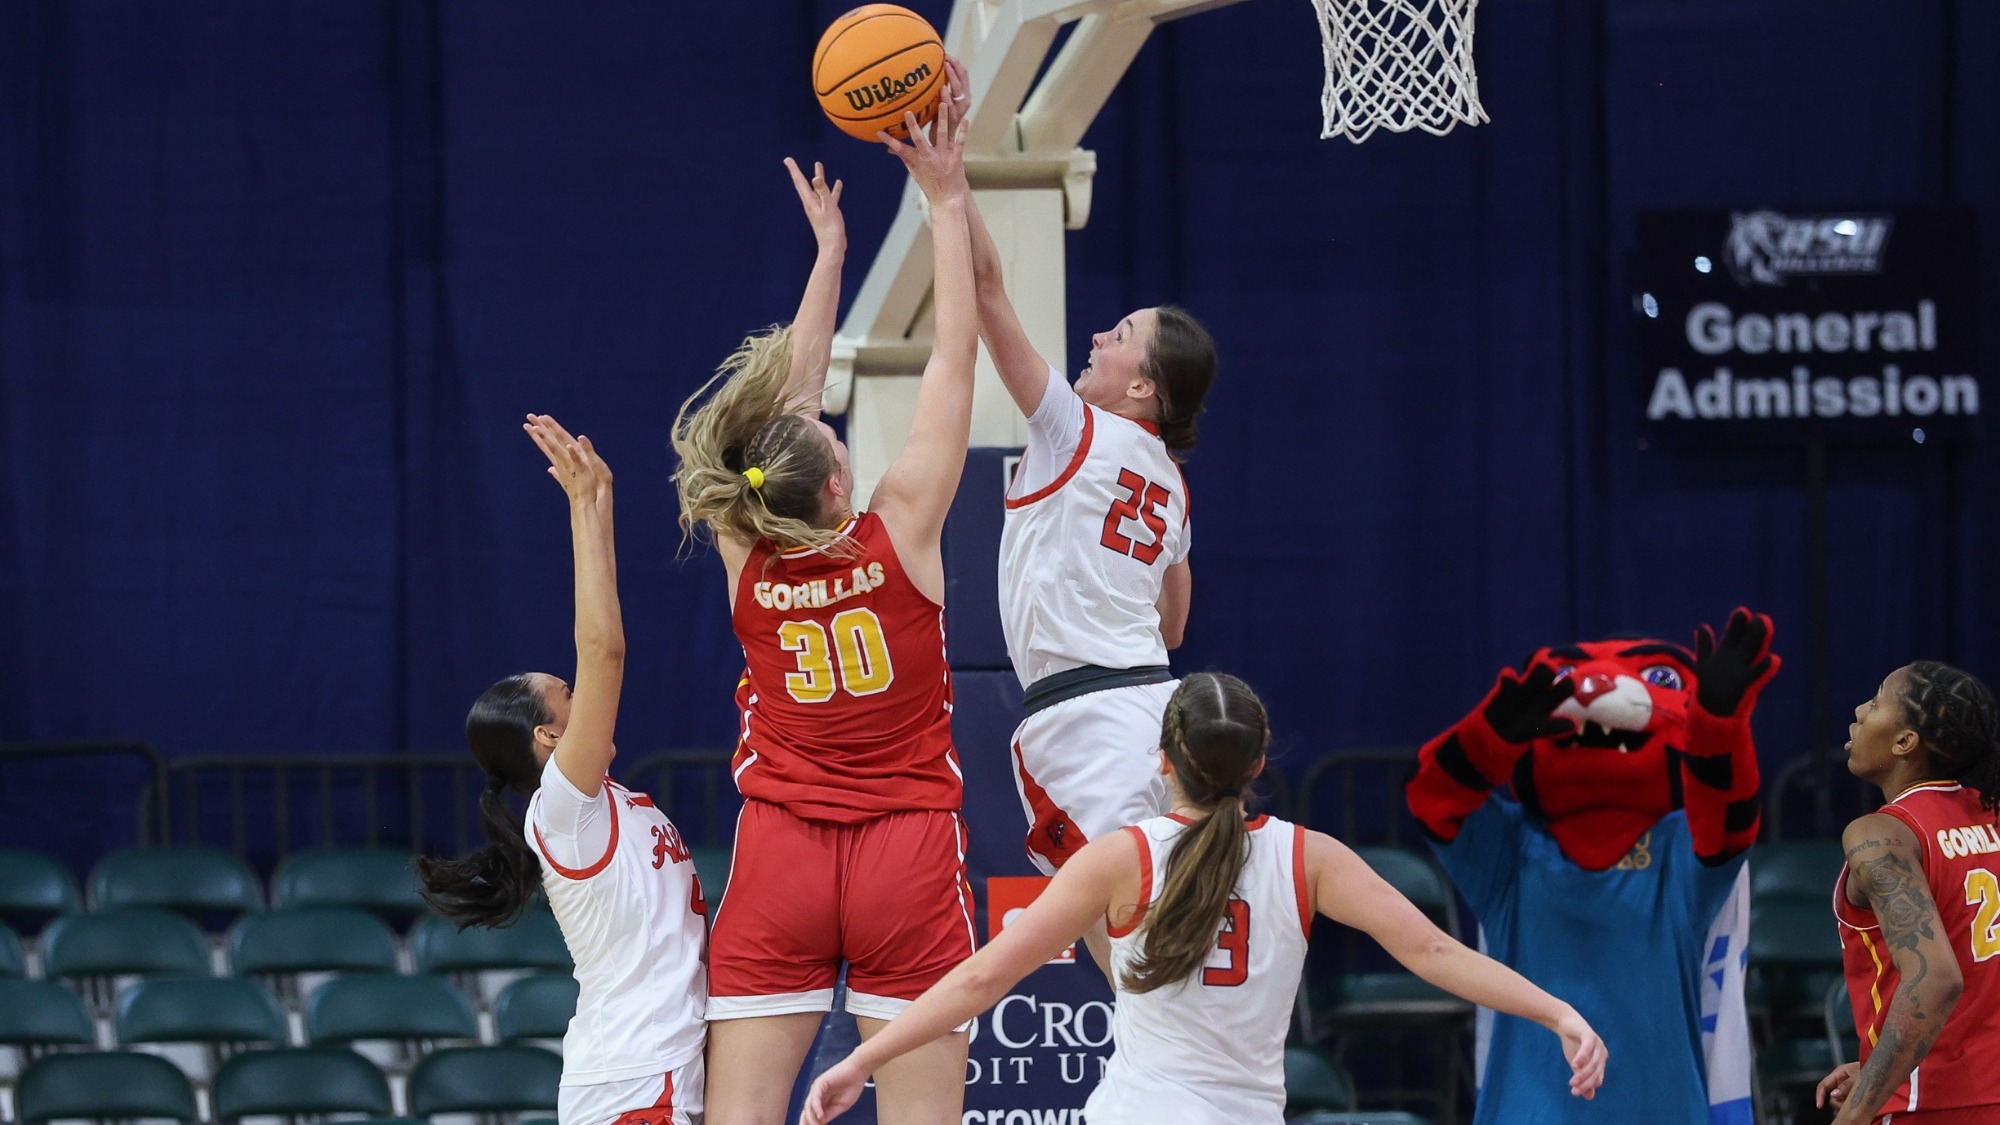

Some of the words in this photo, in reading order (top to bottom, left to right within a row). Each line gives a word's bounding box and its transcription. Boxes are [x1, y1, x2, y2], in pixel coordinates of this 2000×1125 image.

[844, 63, 932, 111] Wilson
[1686, 301, 1937, 354] General
[1647, 366, 1979, 420] Admission
[1100, 467, 1171, 566] 25
[754, 562, 885, 611] GORILLAS
[777, 607, 894, 703] 30
[1963, 868, 2000, 962] 2
[991, 994, 1117, 1049] CRO
[964, 1056, 1033, 1085] DIT
